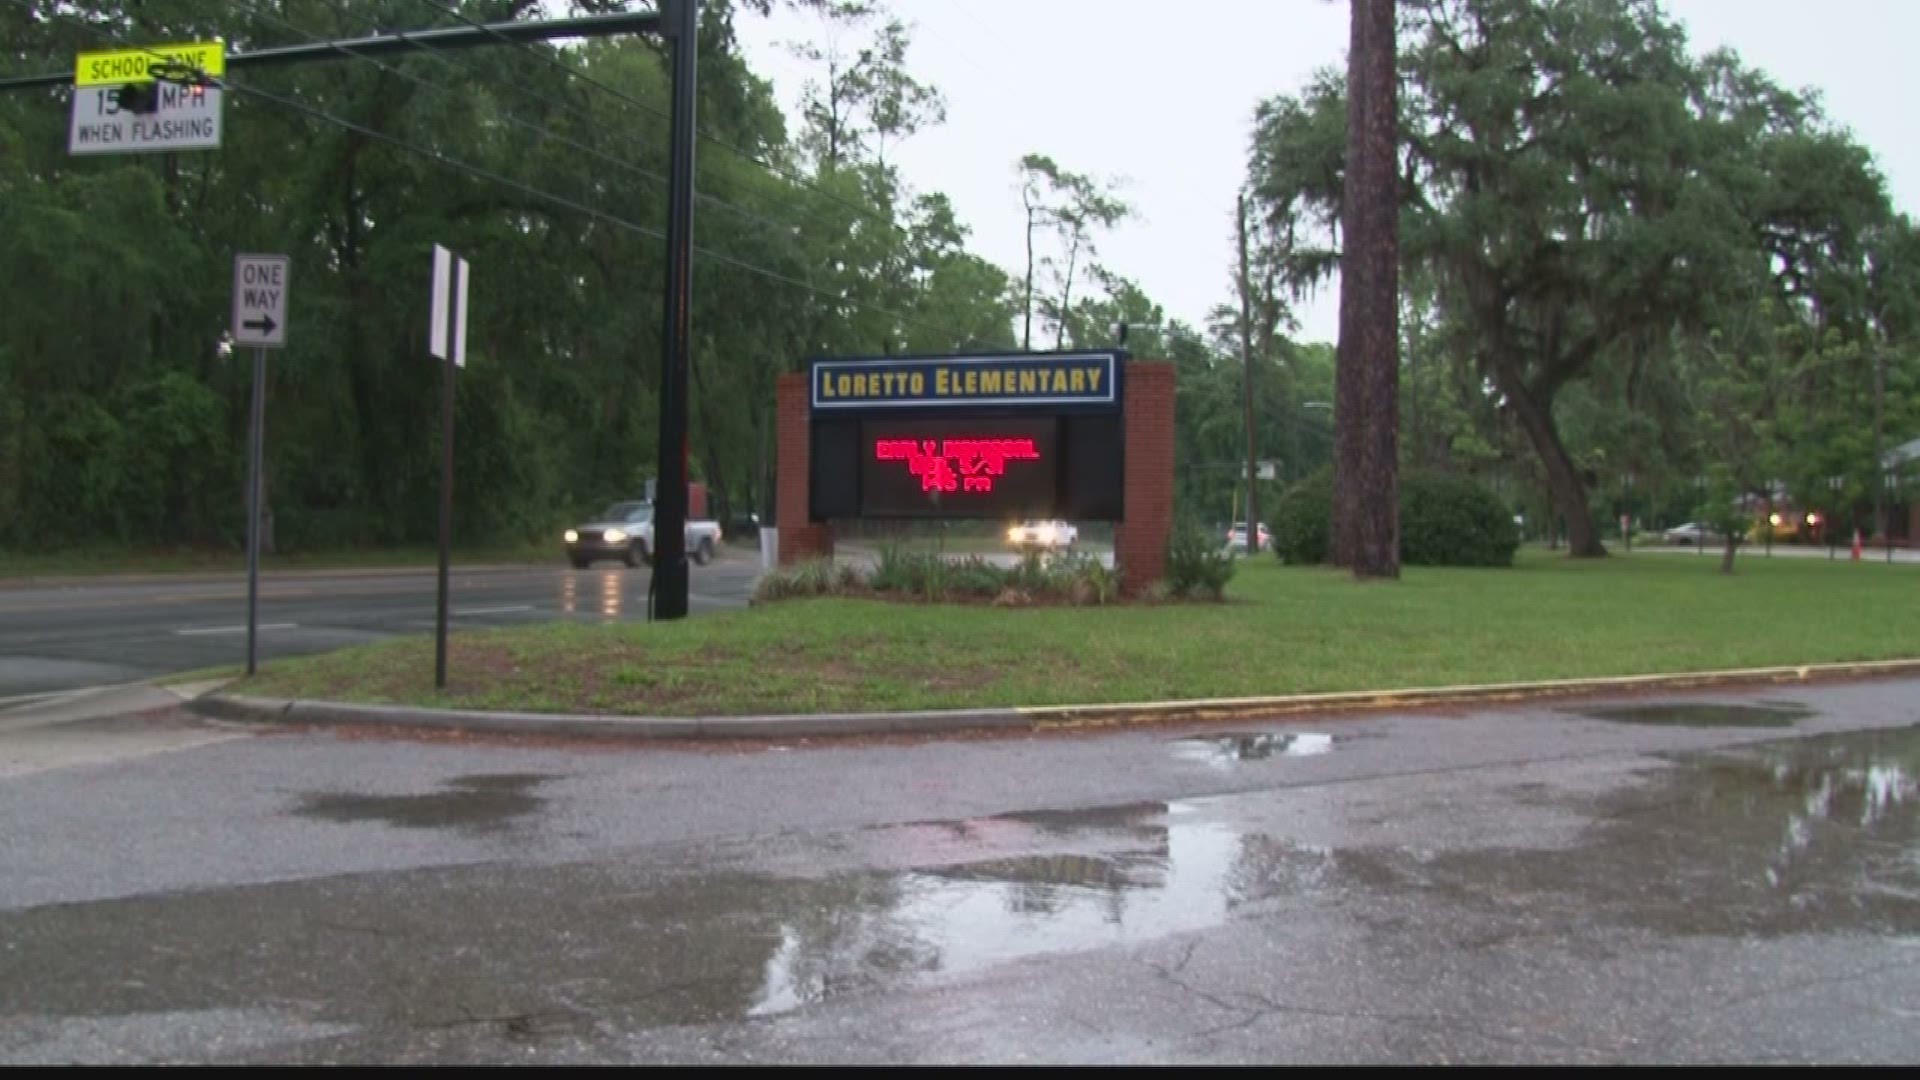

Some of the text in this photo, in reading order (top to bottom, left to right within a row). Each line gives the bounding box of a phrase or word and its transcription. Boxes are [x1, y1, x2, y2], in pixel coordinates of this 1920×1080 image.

[97, 86, 205, 115] 15 MPH
[79, 118, 213, 143] WHEN FLASHING
[244, 264, 282, 285] ONE
[244, 288, 280, 309] WAY
[823, 368, 1102, 397] LORETTO ELEMENTARY
